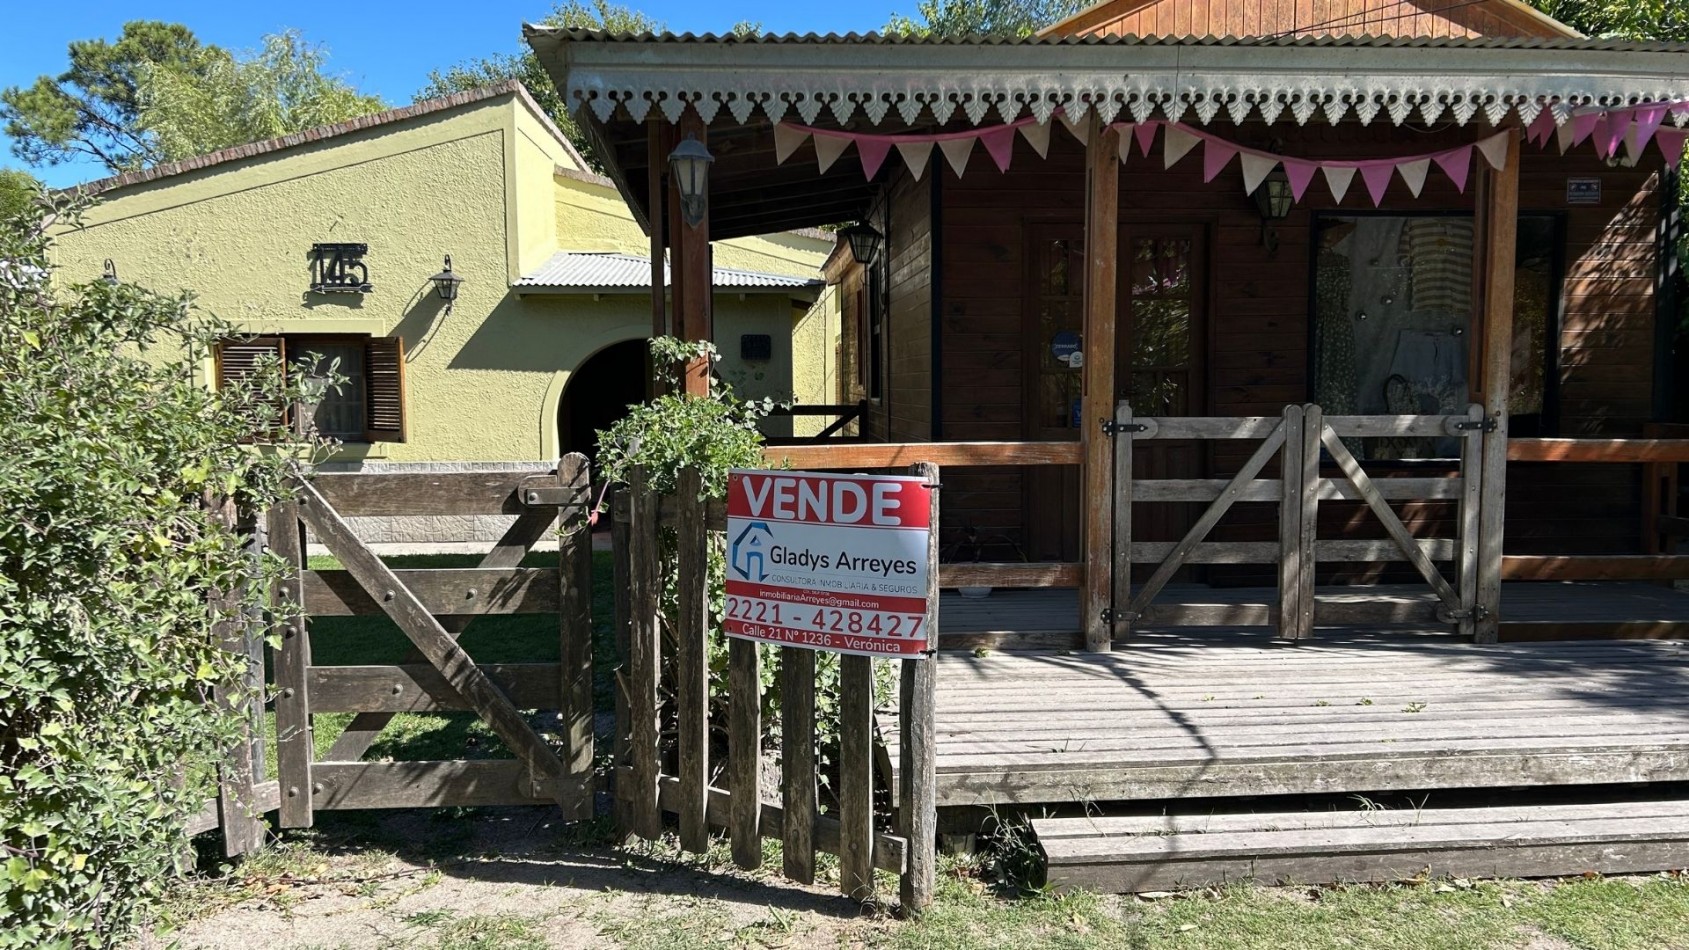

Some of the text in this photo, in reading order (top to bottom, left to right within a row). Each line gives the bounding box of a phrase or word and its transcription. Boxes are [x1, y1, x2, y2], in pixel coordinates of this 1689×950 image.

[313, 245, 368, 288] 145
[742, 476, 902, 525] VENDE
[770, 545, 917, 577] Gladys Arreyes
[759, 588, 879, 609] inmobiliariaArreyes@gmail.com
[772, 574, 918, 594] CONSULTORA NMOBLIARIA & SEGUROS
[728, 597, 782, 625] 2221
[812, 608, 923, 638] 428427
[742, 623, 766, 637] Calle
[768, 627, 782, 640] 21
[802, 632, 832, 646] 1236
[844, 636, 901, 652] Verónica
